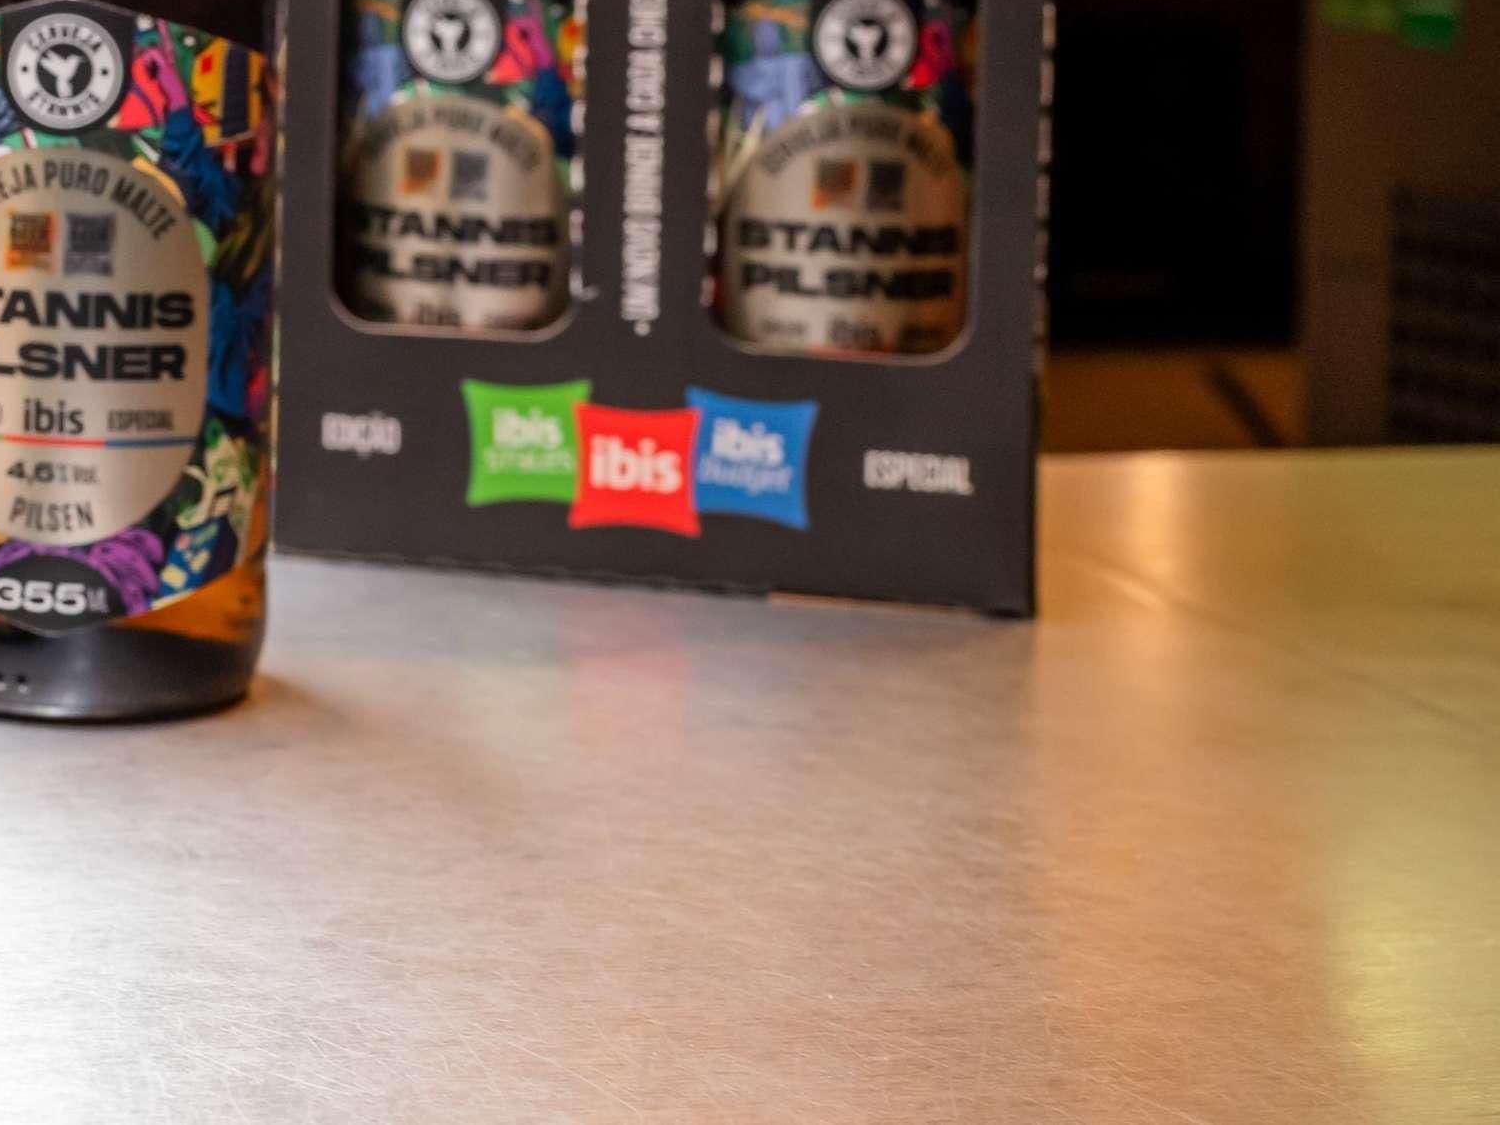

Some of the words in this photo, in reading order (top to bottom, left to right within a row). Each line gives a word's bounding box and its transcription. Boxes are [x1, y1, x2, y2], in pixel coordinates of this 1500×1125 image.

[44, 161, 103, 193] PURO
[23, 398, 84, 435] ibis
[492, 406, 564, 450] ibis
[710, 417, 785, 466] ibis
[590, 434, 682, 495] ibis
[8, 496, 94, 532] PILSEN
